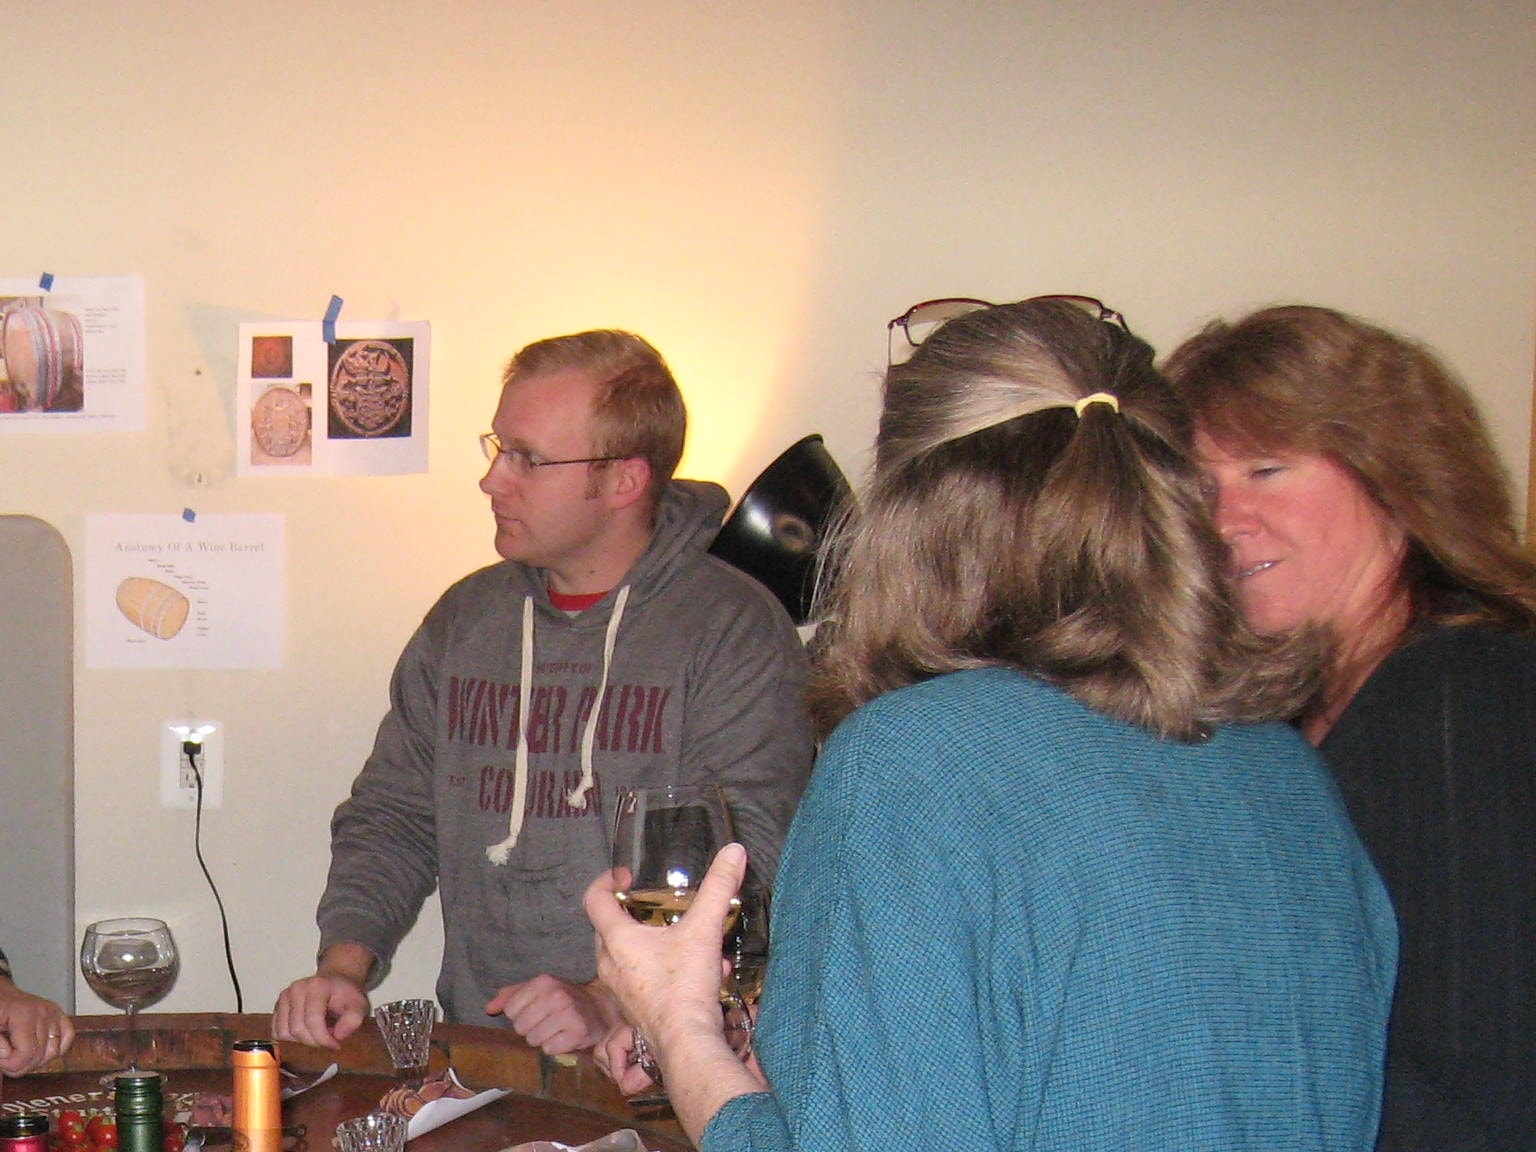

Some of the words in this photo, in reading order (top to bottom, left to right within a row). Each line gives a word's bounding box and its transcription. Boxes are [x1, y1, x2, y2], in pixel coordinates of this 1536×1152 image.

[115, 543, 162, 553] Anatomy
[185, 543, 193, 552] A
[199, 542, 225, 552] Wine
[230, 541, 265, 552] Barrel
[448, 676, 568, 754] WINTER
[570, 684, 672, 754] PARK
